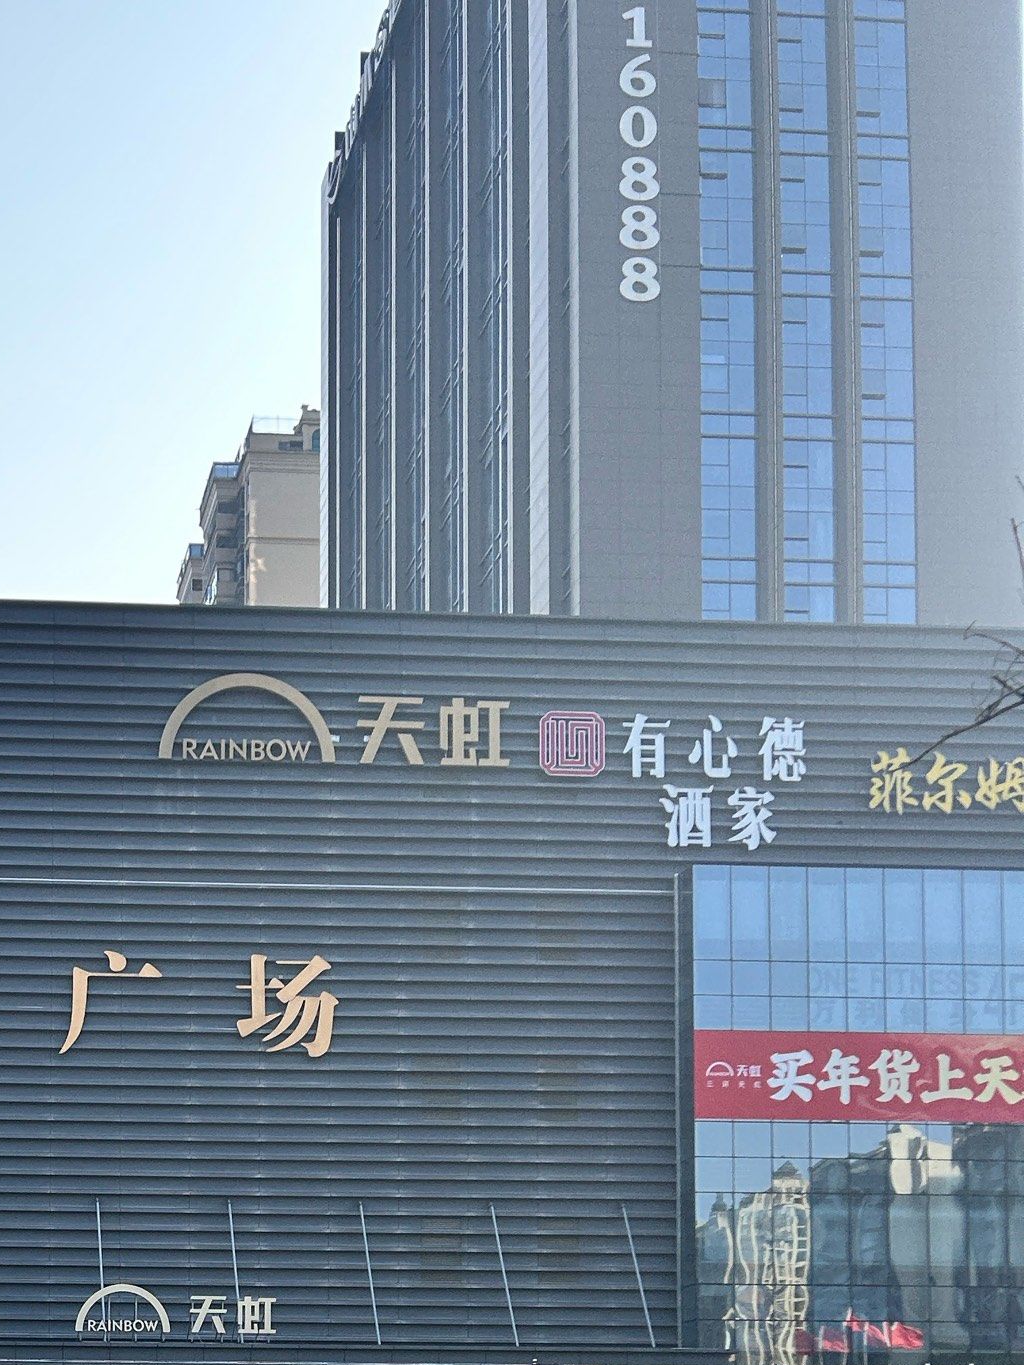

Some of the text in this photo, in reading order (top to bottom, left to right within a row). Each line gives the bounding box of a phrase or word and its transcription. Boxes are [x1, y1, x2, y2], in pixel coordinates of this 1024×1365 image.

[618, 5, 661, 302] 160888
[182, 738, 312, 762] RAINBOW
[356, 695, 511, 767] 天虹
[623, 713, 807, 782] 有心德
[658, 784, 778, 851] 酒家
[766, 1049, 1024, 1105] 买年货上天
[87, 1319, 159, 1332] RAINBOW
[189, 1295, 277, 1334] 天虹
